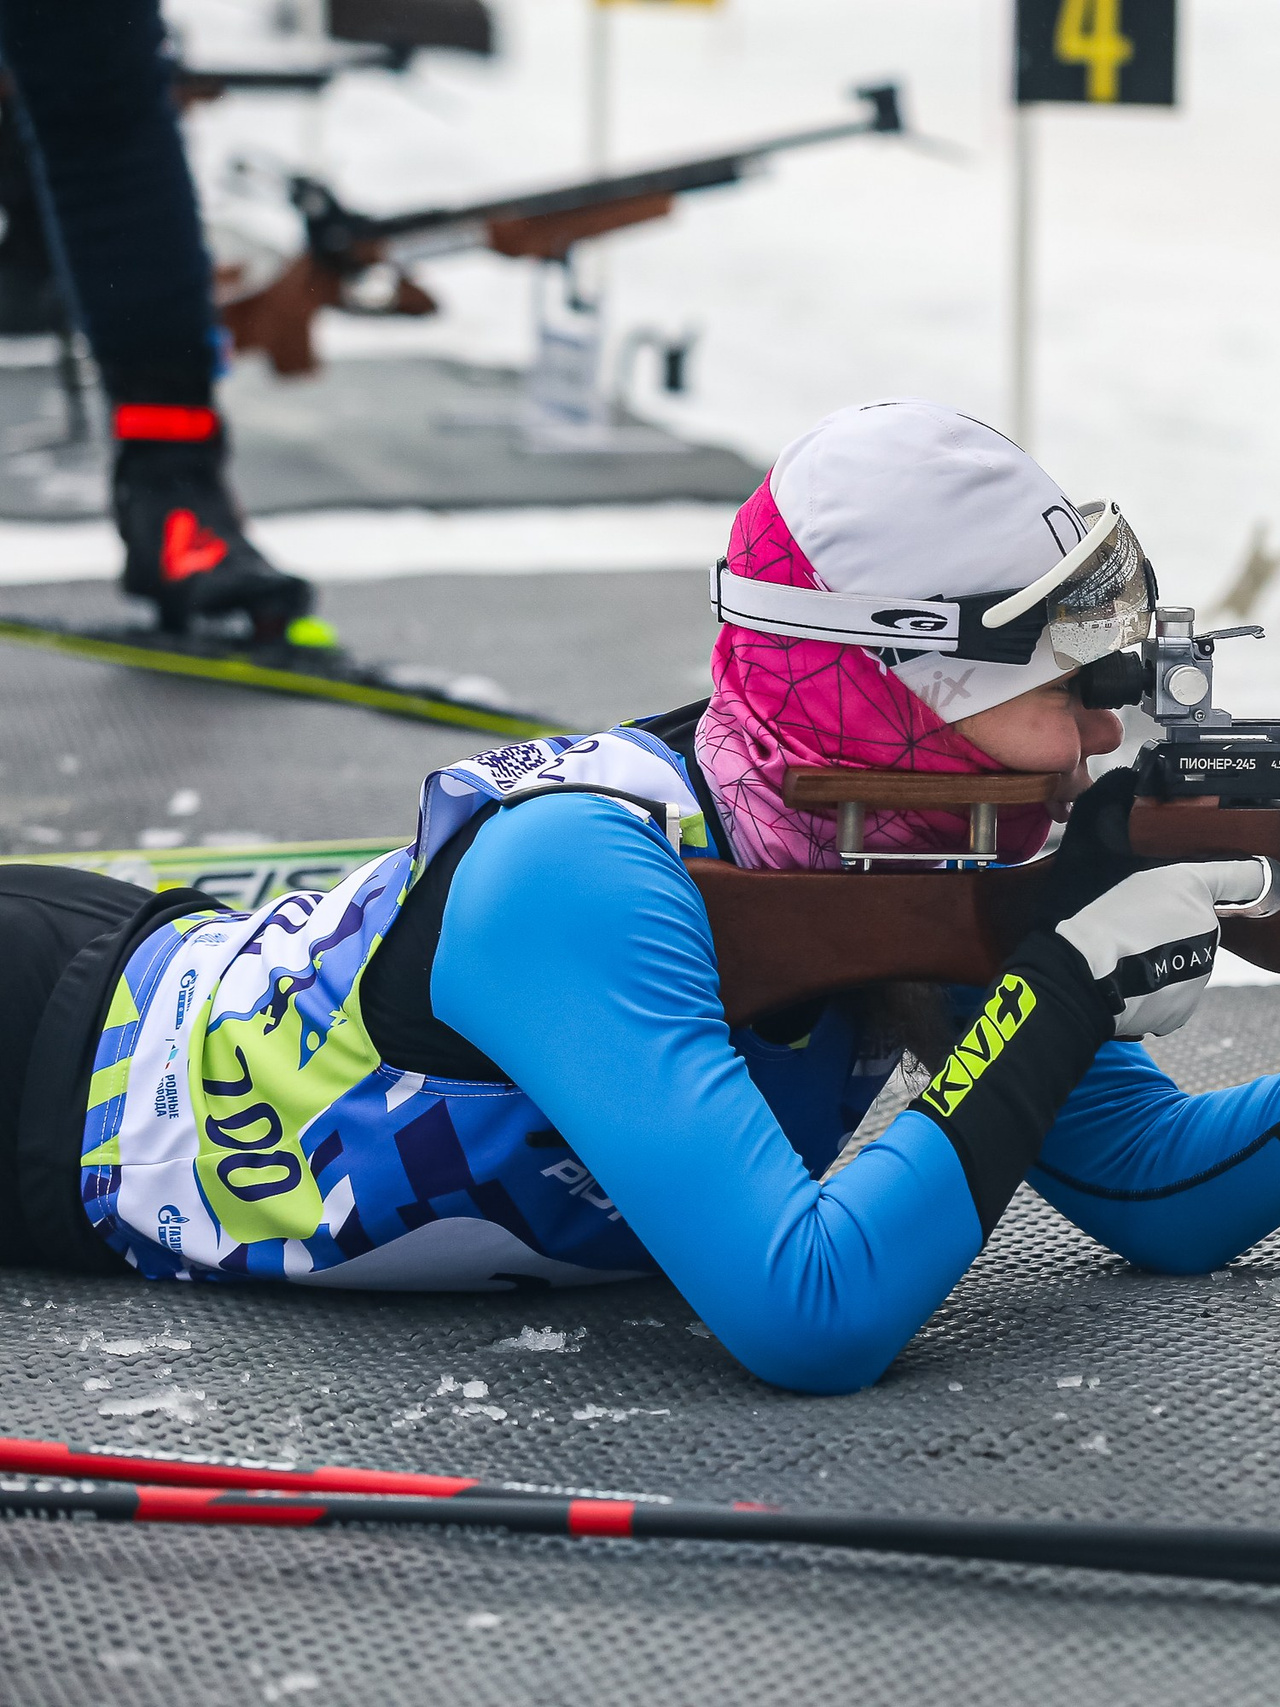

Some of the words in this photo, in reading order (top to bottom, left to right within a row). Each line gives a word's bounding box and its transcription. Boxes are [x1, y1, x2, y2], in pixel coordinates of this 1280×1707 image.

[1055, 0, 1134, 103] 4
[1179, 757, 1257, 770] ПИОНЕР-245
[1154, 946, 1212, 977] MOAX
[165, 1073, 179, 1119] РОДНЫЕ
